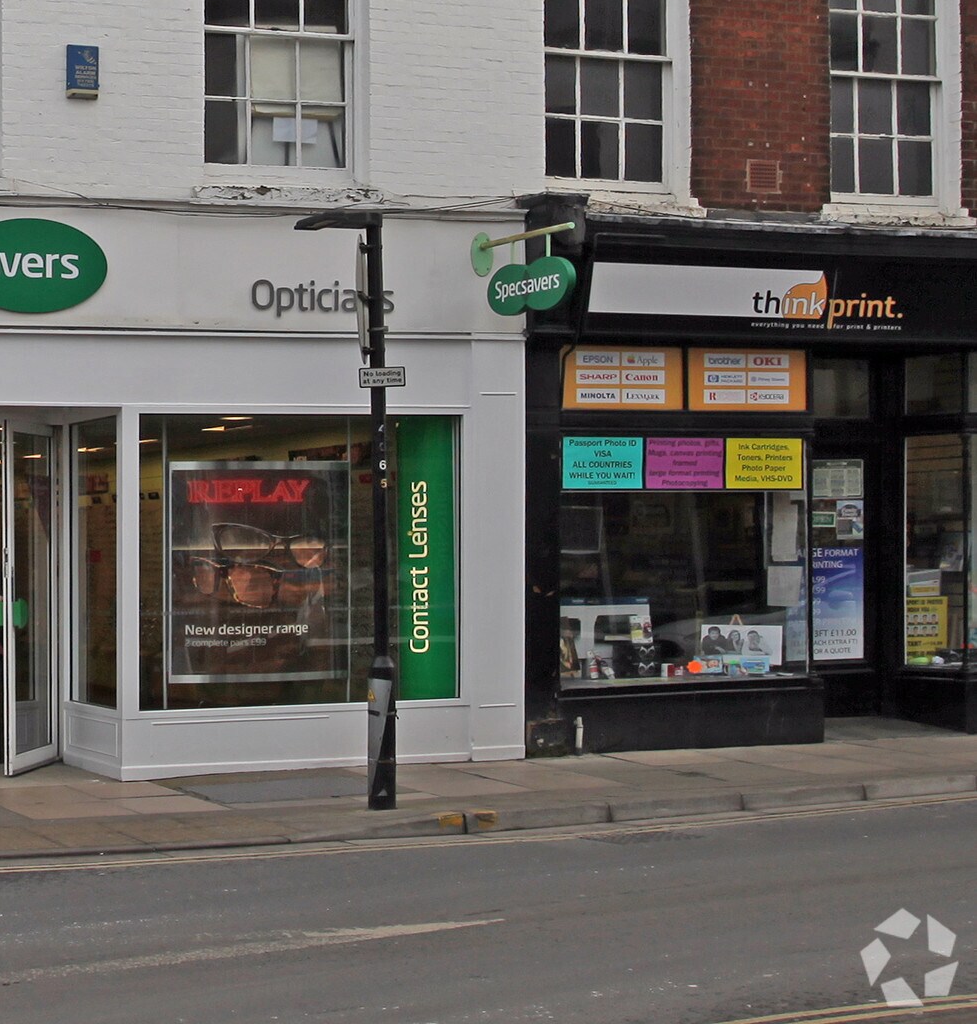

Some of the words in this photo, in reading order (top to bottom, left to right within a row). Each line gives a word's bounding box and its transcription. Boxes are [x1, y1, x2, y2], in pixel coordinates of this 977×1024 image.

[494, 273, 560, 303] Specsavers
[251, 279, 395, 317] Opticias
[582, 355, 614, 364] EPSON
[637, 355, 658, 366] Apple
[709, 356, 741, 365] brother
[753, 356, 782, 366] OKI
[625, 373, 658, 381] Canon
[568, 439, 602, 447] Passport
[604, 439, 627, 447] Photo
[628, 439, 637, 447] ID
[379, 459, 387, 470] 6
[765, 464, 787, 472] Paper
[380, 478, 388, 488] 5
[187, 478, 310, 503] REPLAY
[408, 480, 428, 559] Lenses
[824, 548, 859, 557] FORMAT
[409, 566, 430, 653] Contact
[185, 624, 215, 636] New
[218, 624, 273, 637] designer
[276, 623, 309, 638] range
[830, 629, 857, 637] £11.00
[191, 638, 229, 648] complete
[230, 638, 250, 648] pairs
